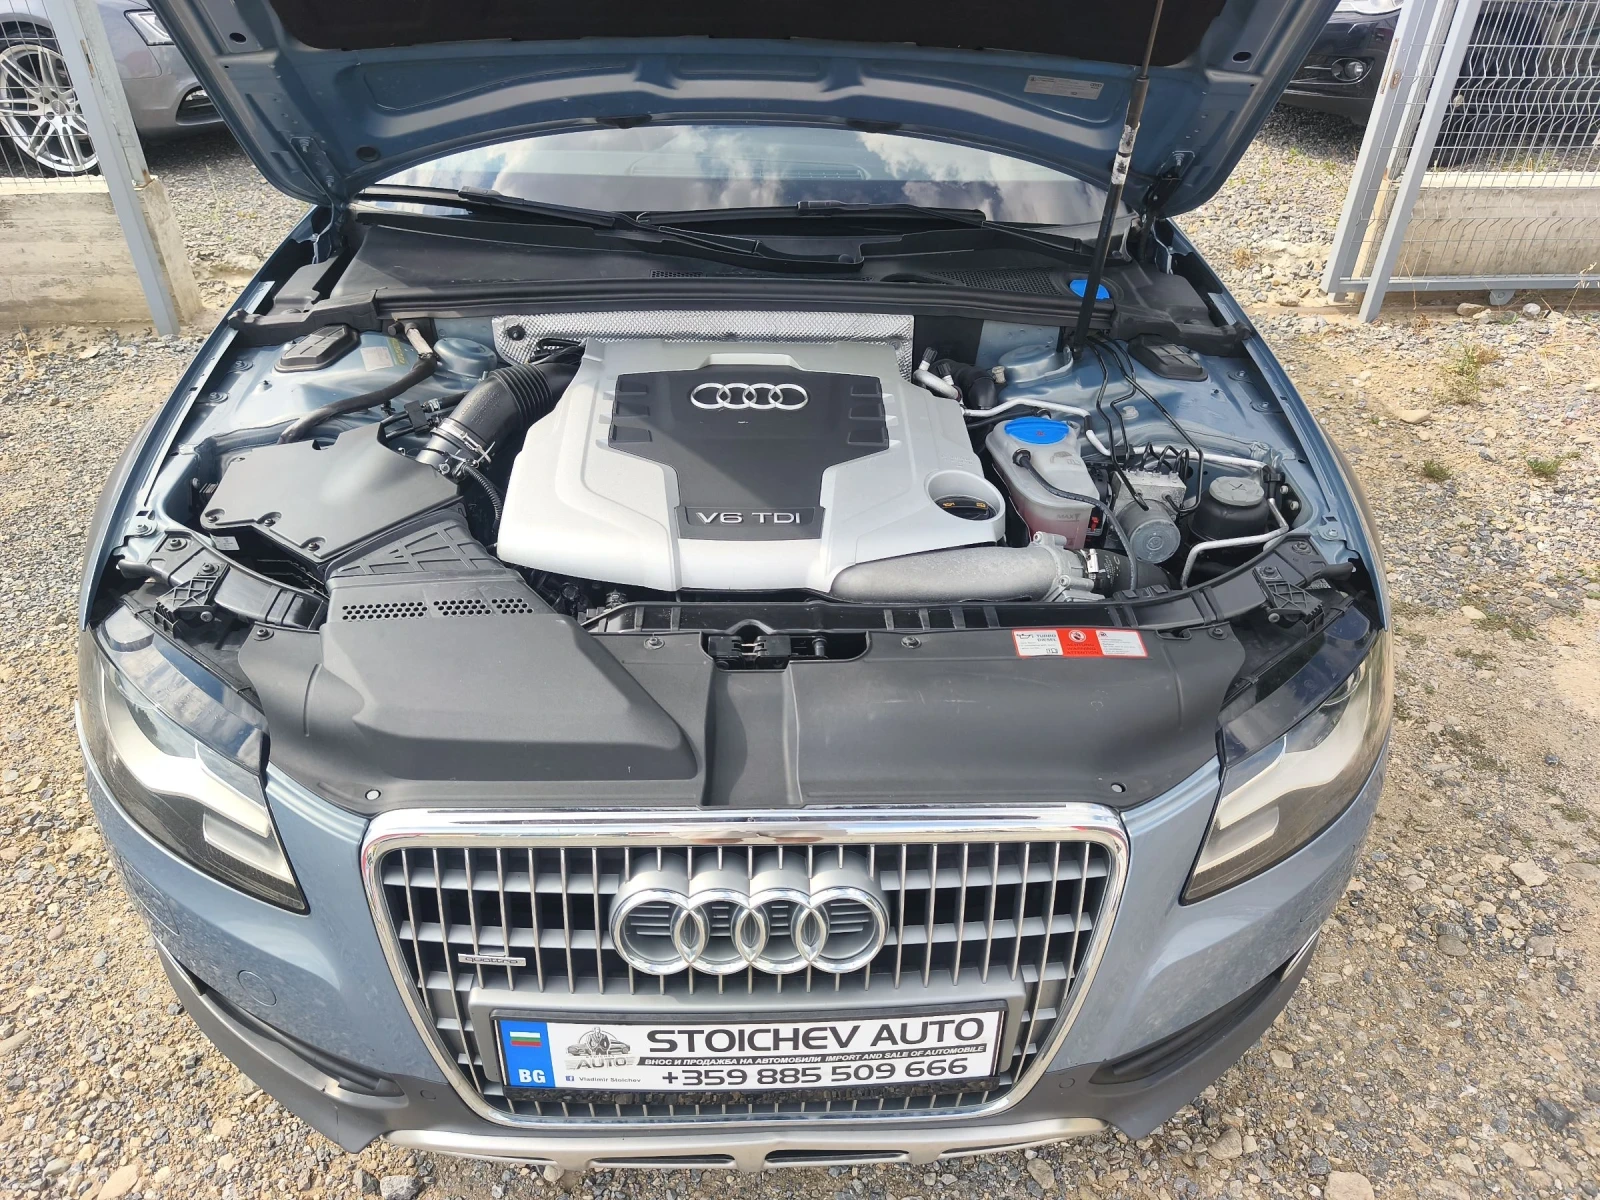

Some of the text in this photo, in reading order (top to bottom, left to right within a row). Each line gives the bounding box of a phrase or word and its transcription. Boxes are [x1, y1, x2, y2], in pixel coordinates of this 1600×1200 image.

[696, 512, 801, 524] V6 TDI
[647, 1017, 985, 1053] STOICHEV AUTO
[645, 1056, 822, 1066] ВНОС И ПРОДАЖБА НА АВТОМОБИЛИ
[825, 1054, 862, 1062] IMPORT
[862, 1053, 883, 1061] AND
[884, 1051, 909, 1059] SALE
[924, 1045, 985, 1056] AUTOMOBILE
[577, 1057, 627, 1069] AUTO
[518, 1068, 546, 1083] BG
[662, 1057, 968, 1086] +359 885 509 666
